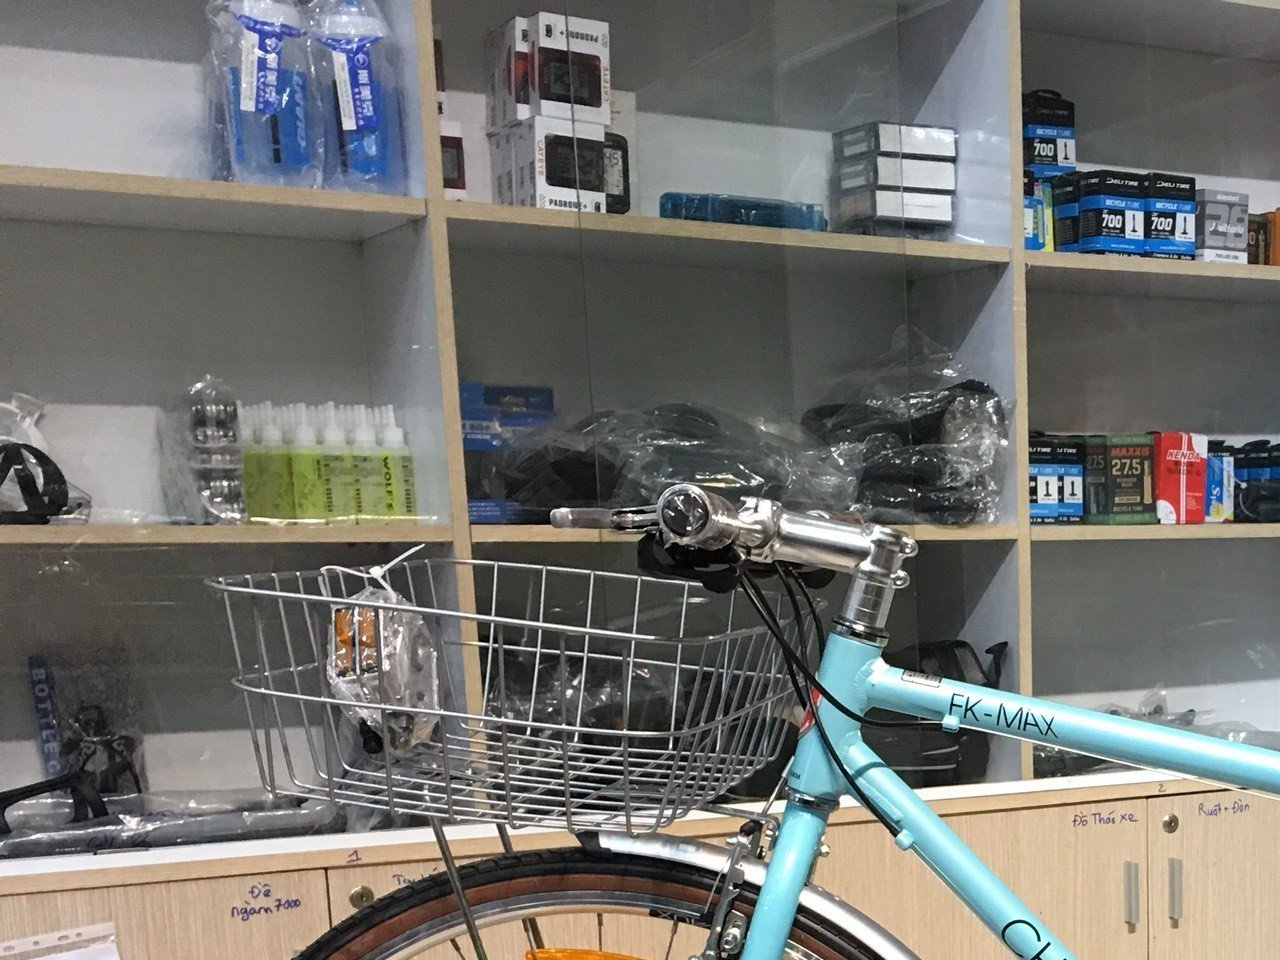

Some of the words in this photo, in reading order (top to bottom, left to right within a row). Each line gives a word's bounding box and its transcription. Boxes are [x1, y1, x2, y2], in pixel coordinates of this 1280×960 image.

[1033, 142, 1054, 157] 700
[1102, 213, 1123, 229] 700
[1151, 216, 1173, 231] 700
[1110, 446, 1150, 457] MAXXIS
[1166, 449, 1201, 462] KENDA
[1111, 458, 1141, 475] 27.5
[949, 692, 1059, 739] FK-MAX
[1157, 783, 1167, 793] 2
[345, 849, 361, 863] 1
